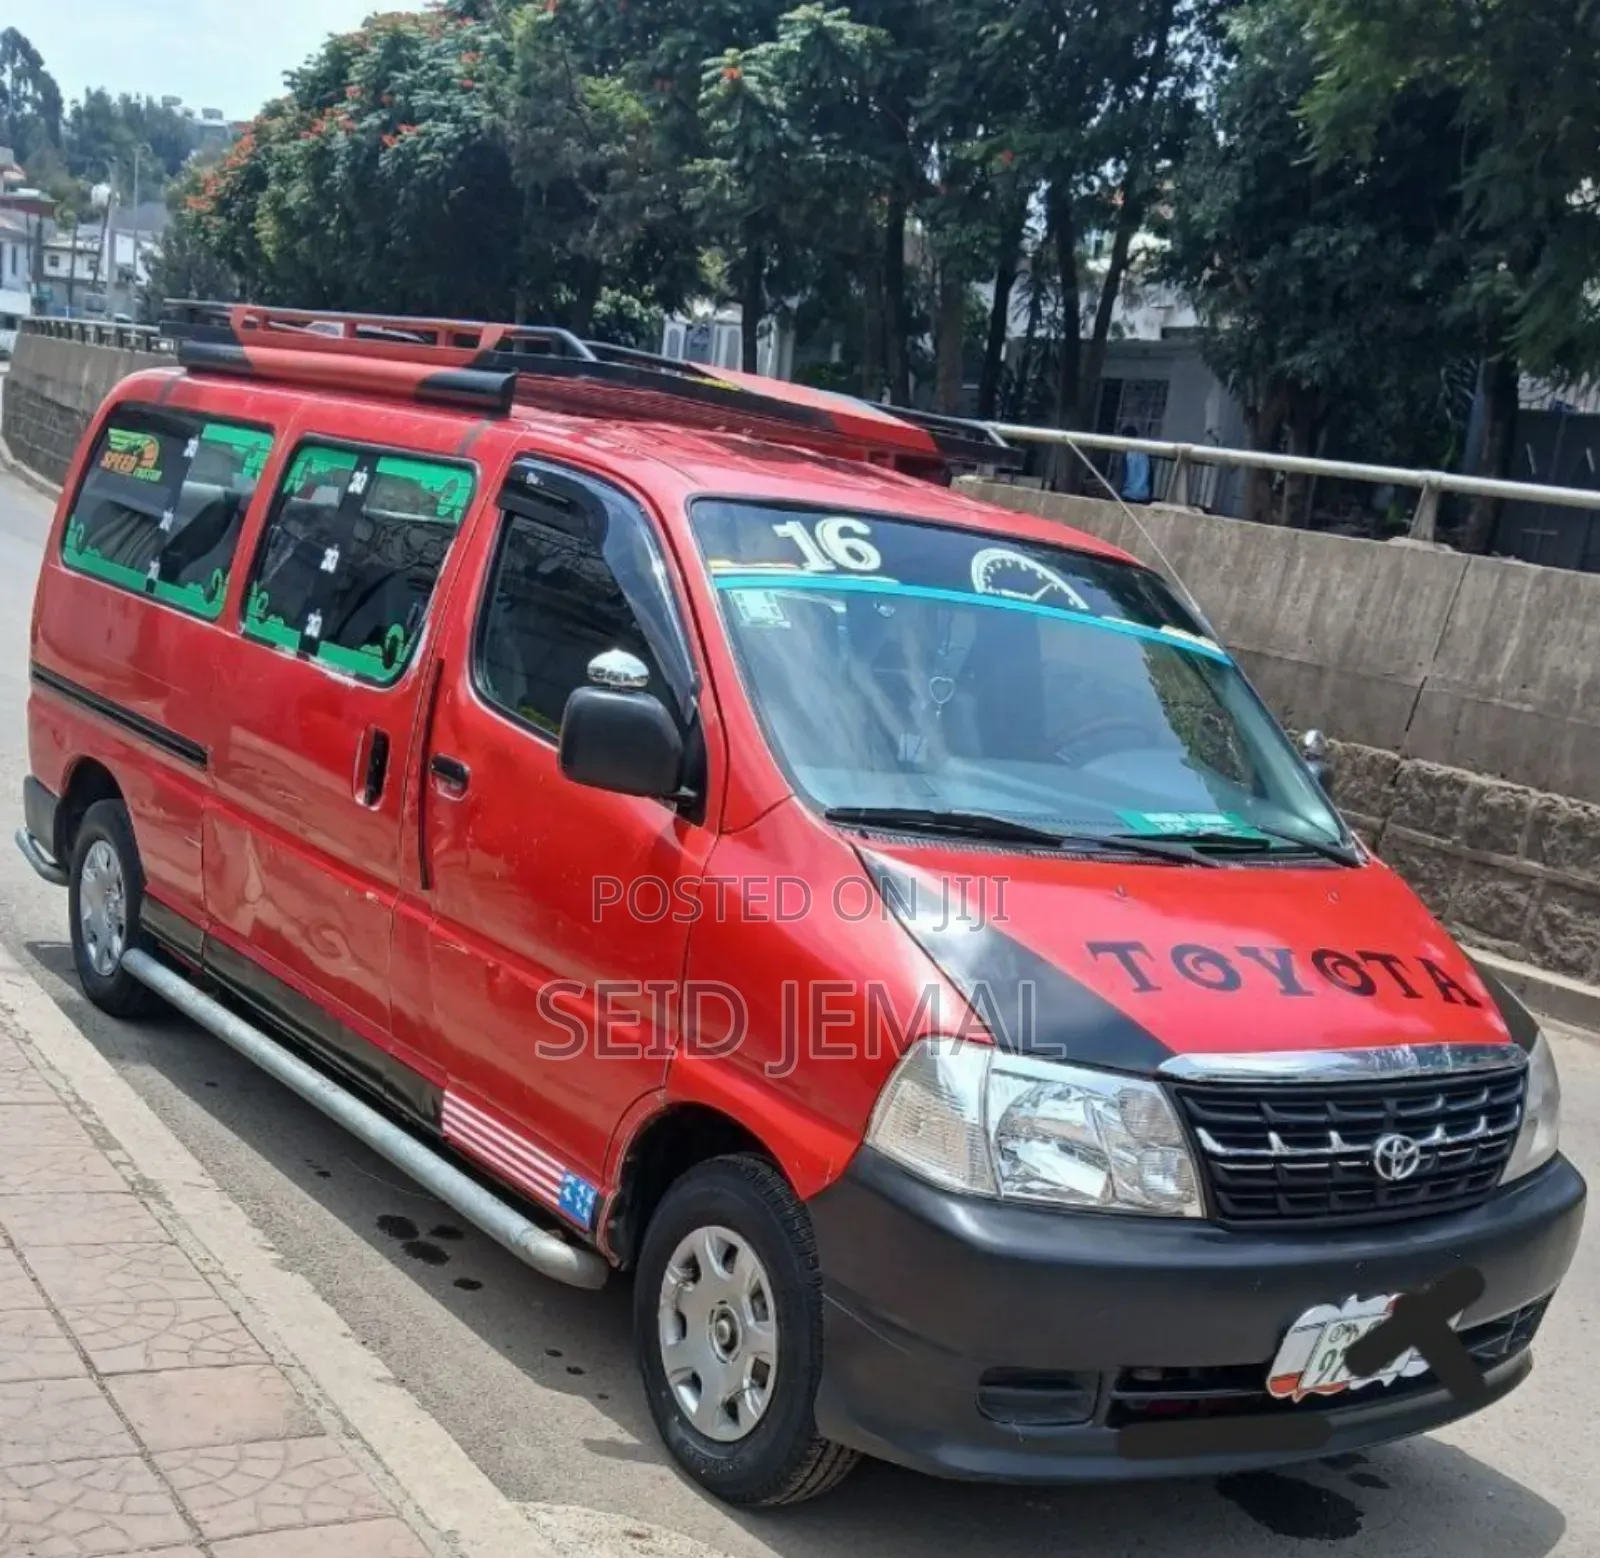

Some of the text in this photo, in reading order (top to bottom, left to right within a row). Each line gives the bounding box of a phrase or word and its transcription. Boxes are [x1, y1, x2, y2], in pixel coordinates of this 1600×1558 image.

[100, 451, 138, 474] SPEED
[772, 516, 881, 572] 16
[1085, 940, 1482, 1009] TOYOTA
